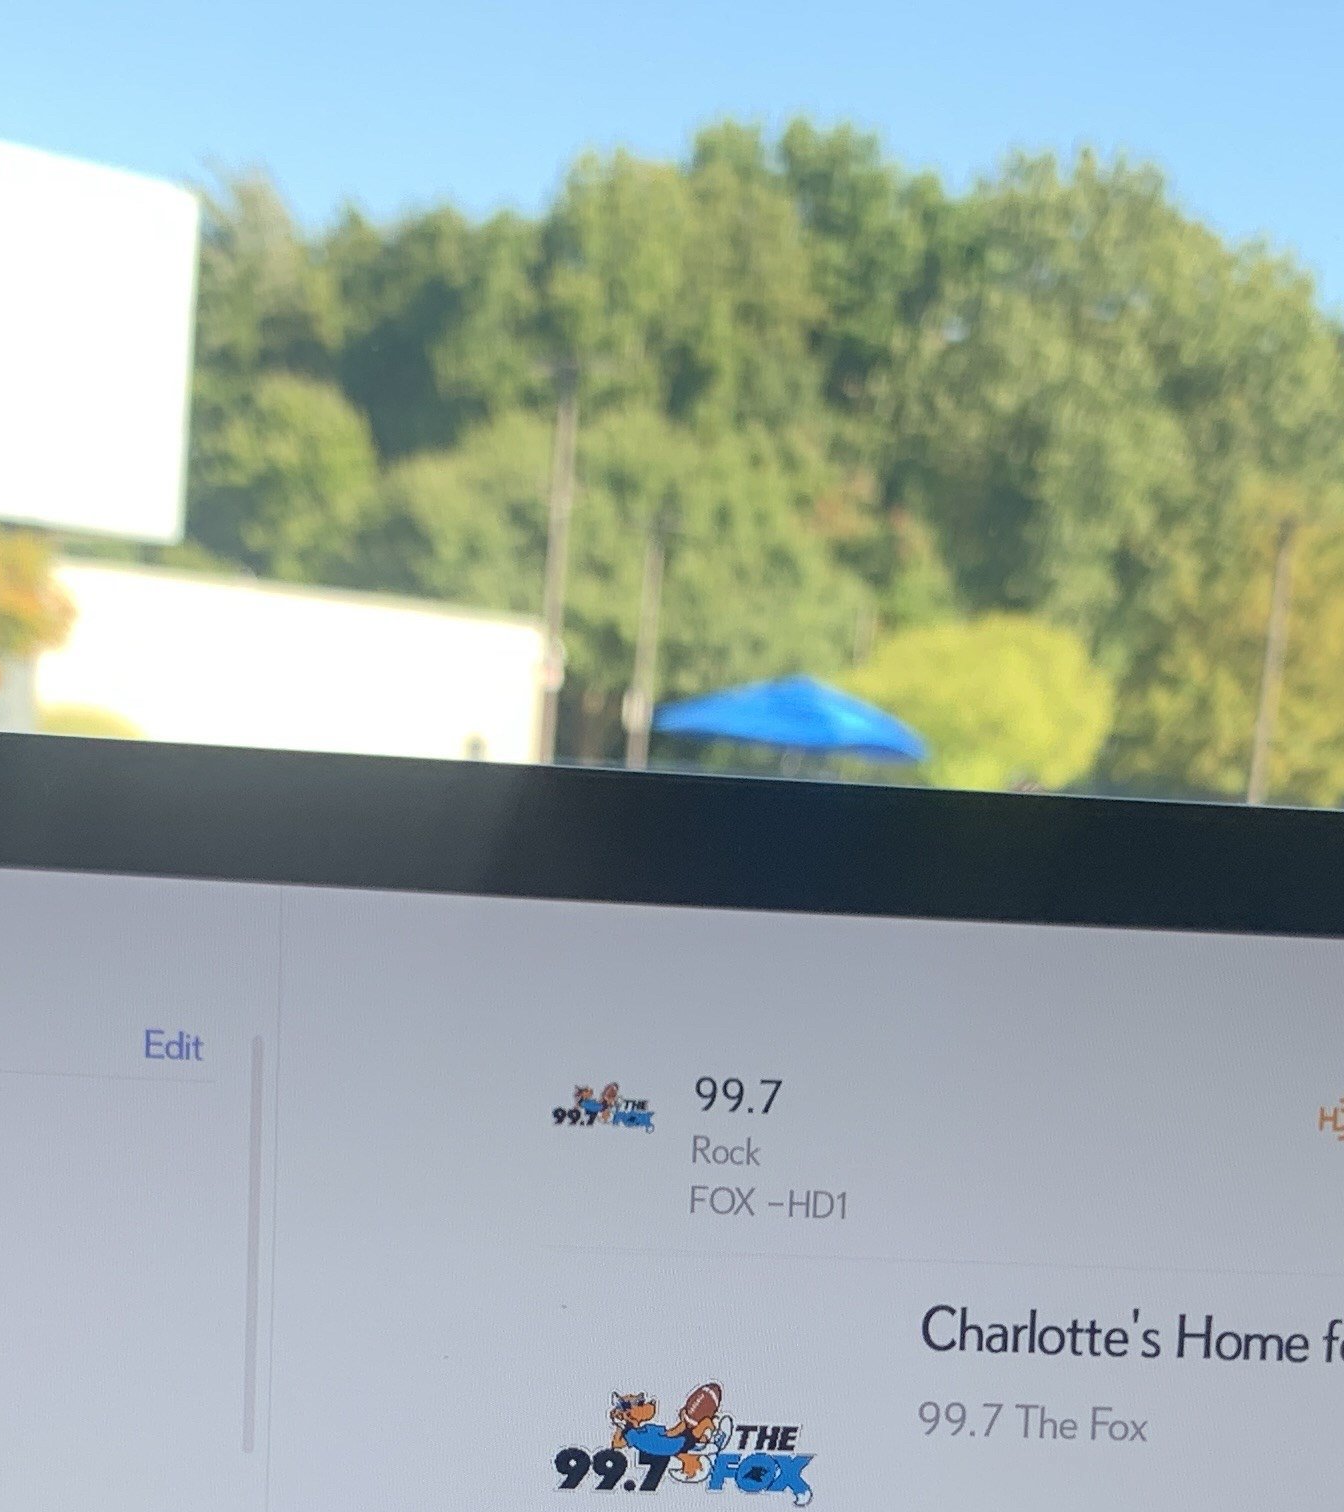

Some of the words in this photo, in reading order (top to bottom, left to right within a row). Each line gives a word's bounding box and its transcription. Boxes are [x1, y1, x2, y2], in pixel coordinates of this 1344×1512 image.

[145, 1029, 203, 1060] Edit
[696, 1077, 782, 1114] 99.7
[692, 1135, 760, 1166] Rock
[690, 1185, 755, 1216] FOX
[922, 1305, 1160, 1358] Charlotte's
[1177, 1314, 1309, 1363] Home
[735, 1424, 800, 1451] THE
[919, 1401, 1003, 1437] 99.7
[1015, 1404, 1078, 1439] The
[1091, 1406, 1147, 1441] Fox
[555, 1448, 670, 1492] 99.7
[708, 1454, 815, 1494] FOX
